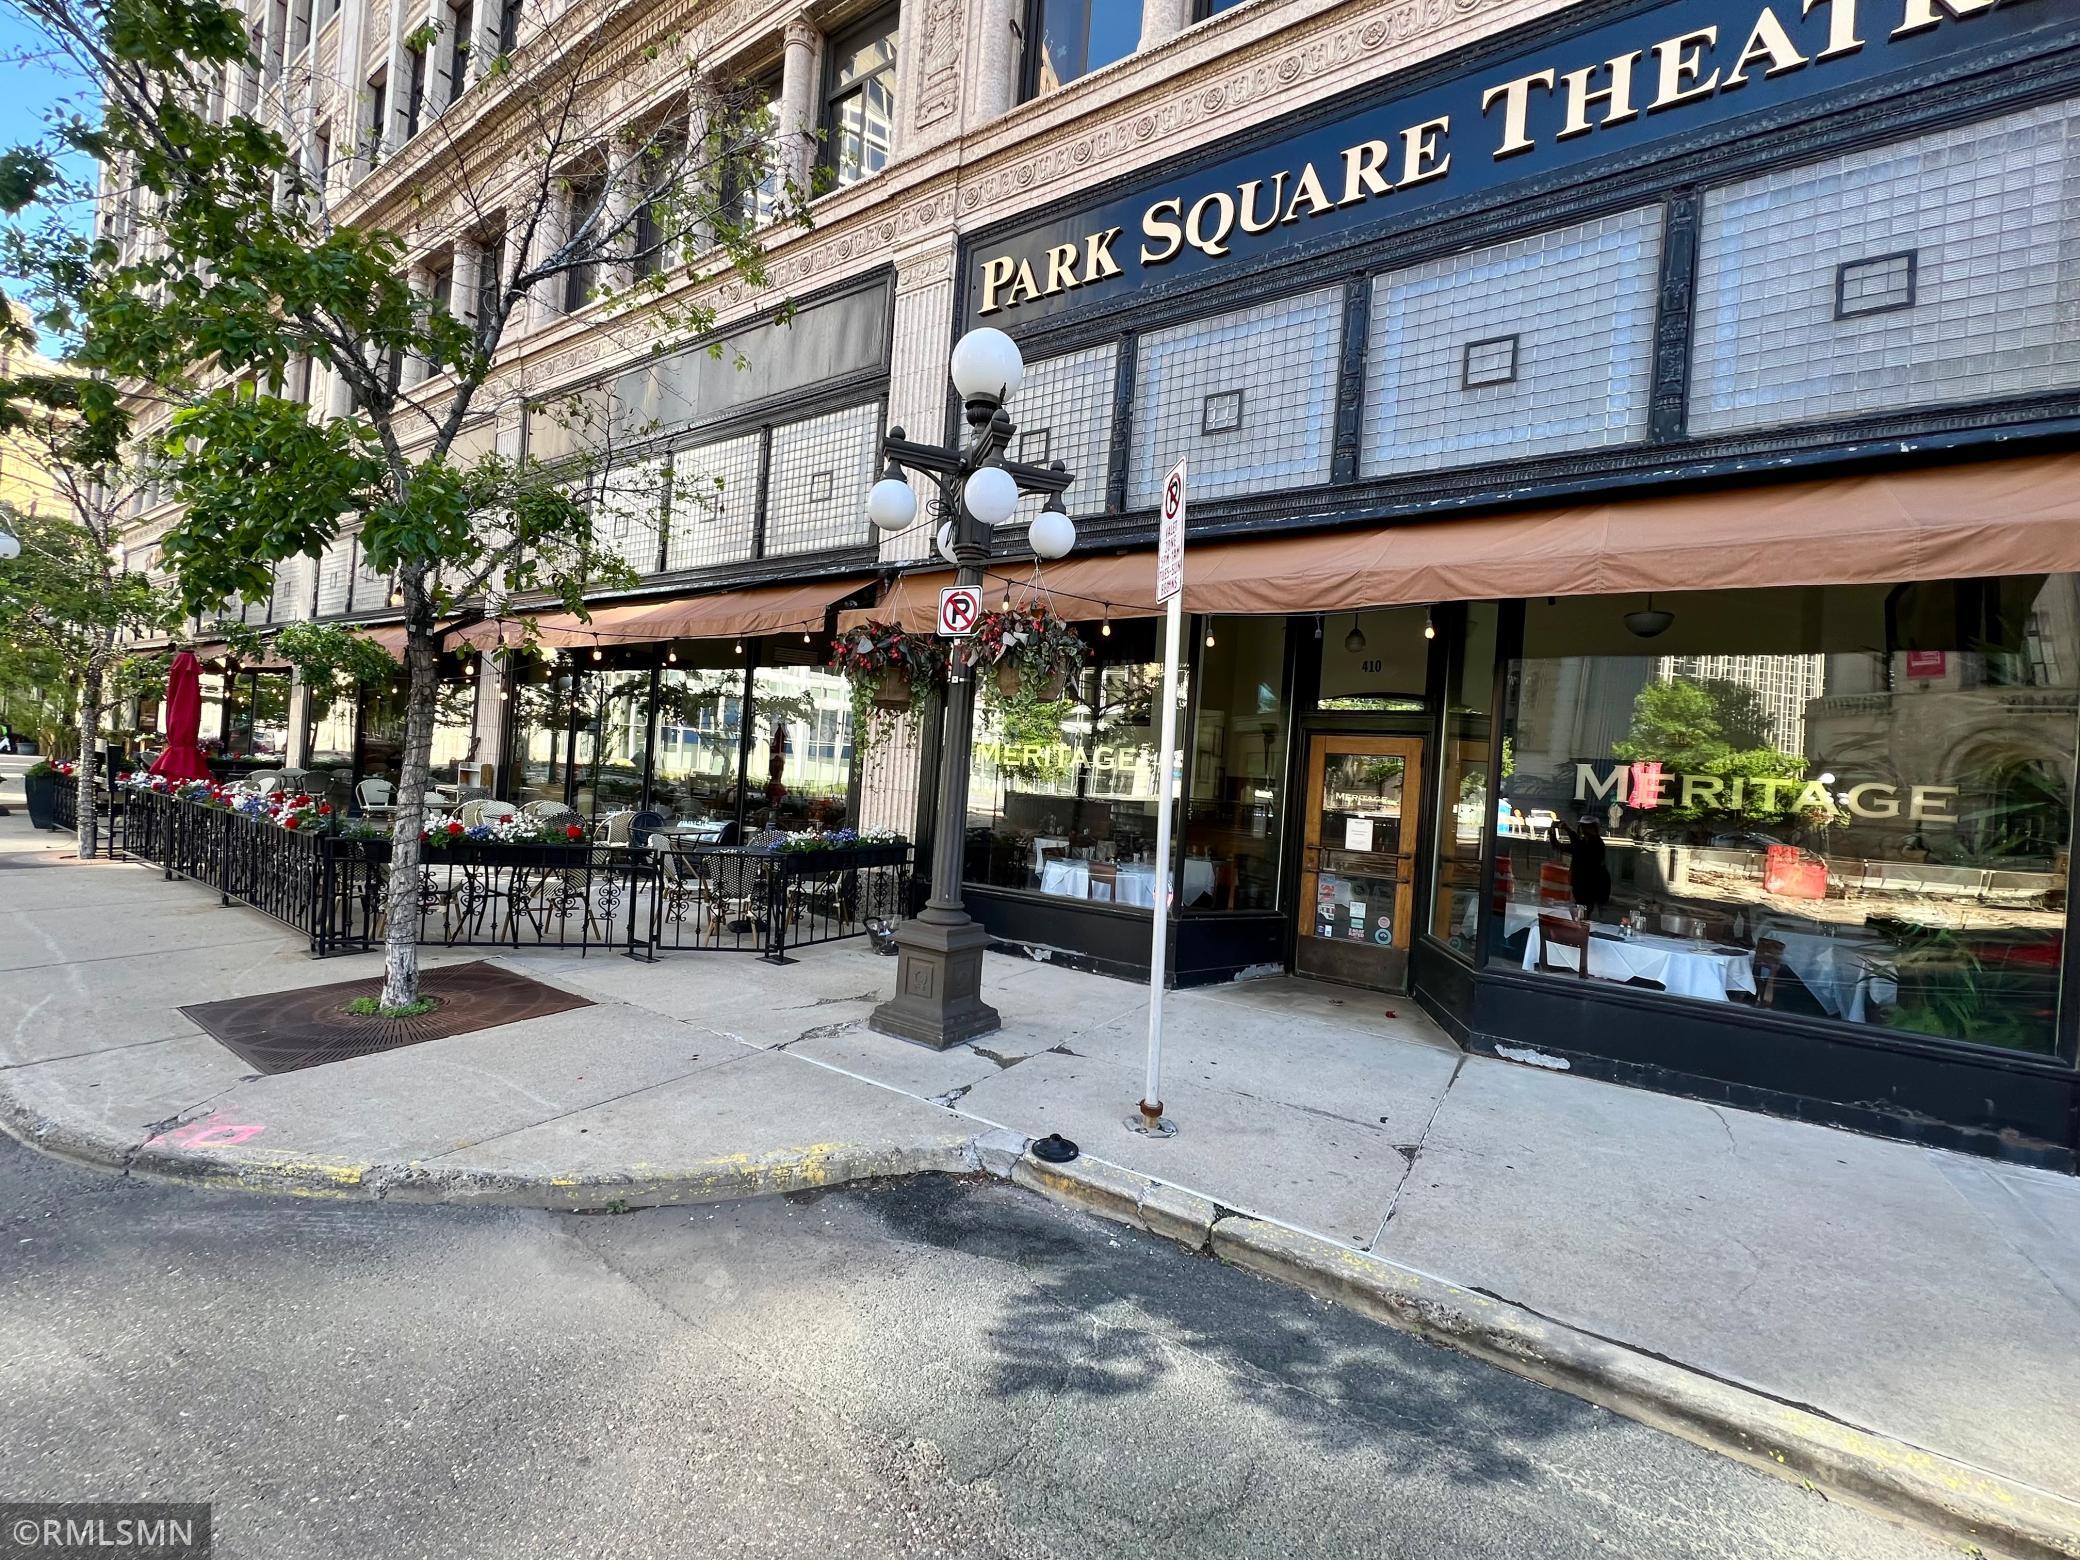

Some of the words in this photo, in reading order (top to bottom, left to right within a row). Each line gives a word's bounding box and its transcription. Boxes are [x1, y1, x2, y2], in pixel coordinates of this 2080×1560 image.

[977, 226, 1122, 315] PARK
[1140, 115, 1452, 264] SQUARE
[1362, 660, 1382, 672] 410
[975, 741, 1138, 771] MERITAGE
[1574, 763, 1960, 823] MERITAGE
